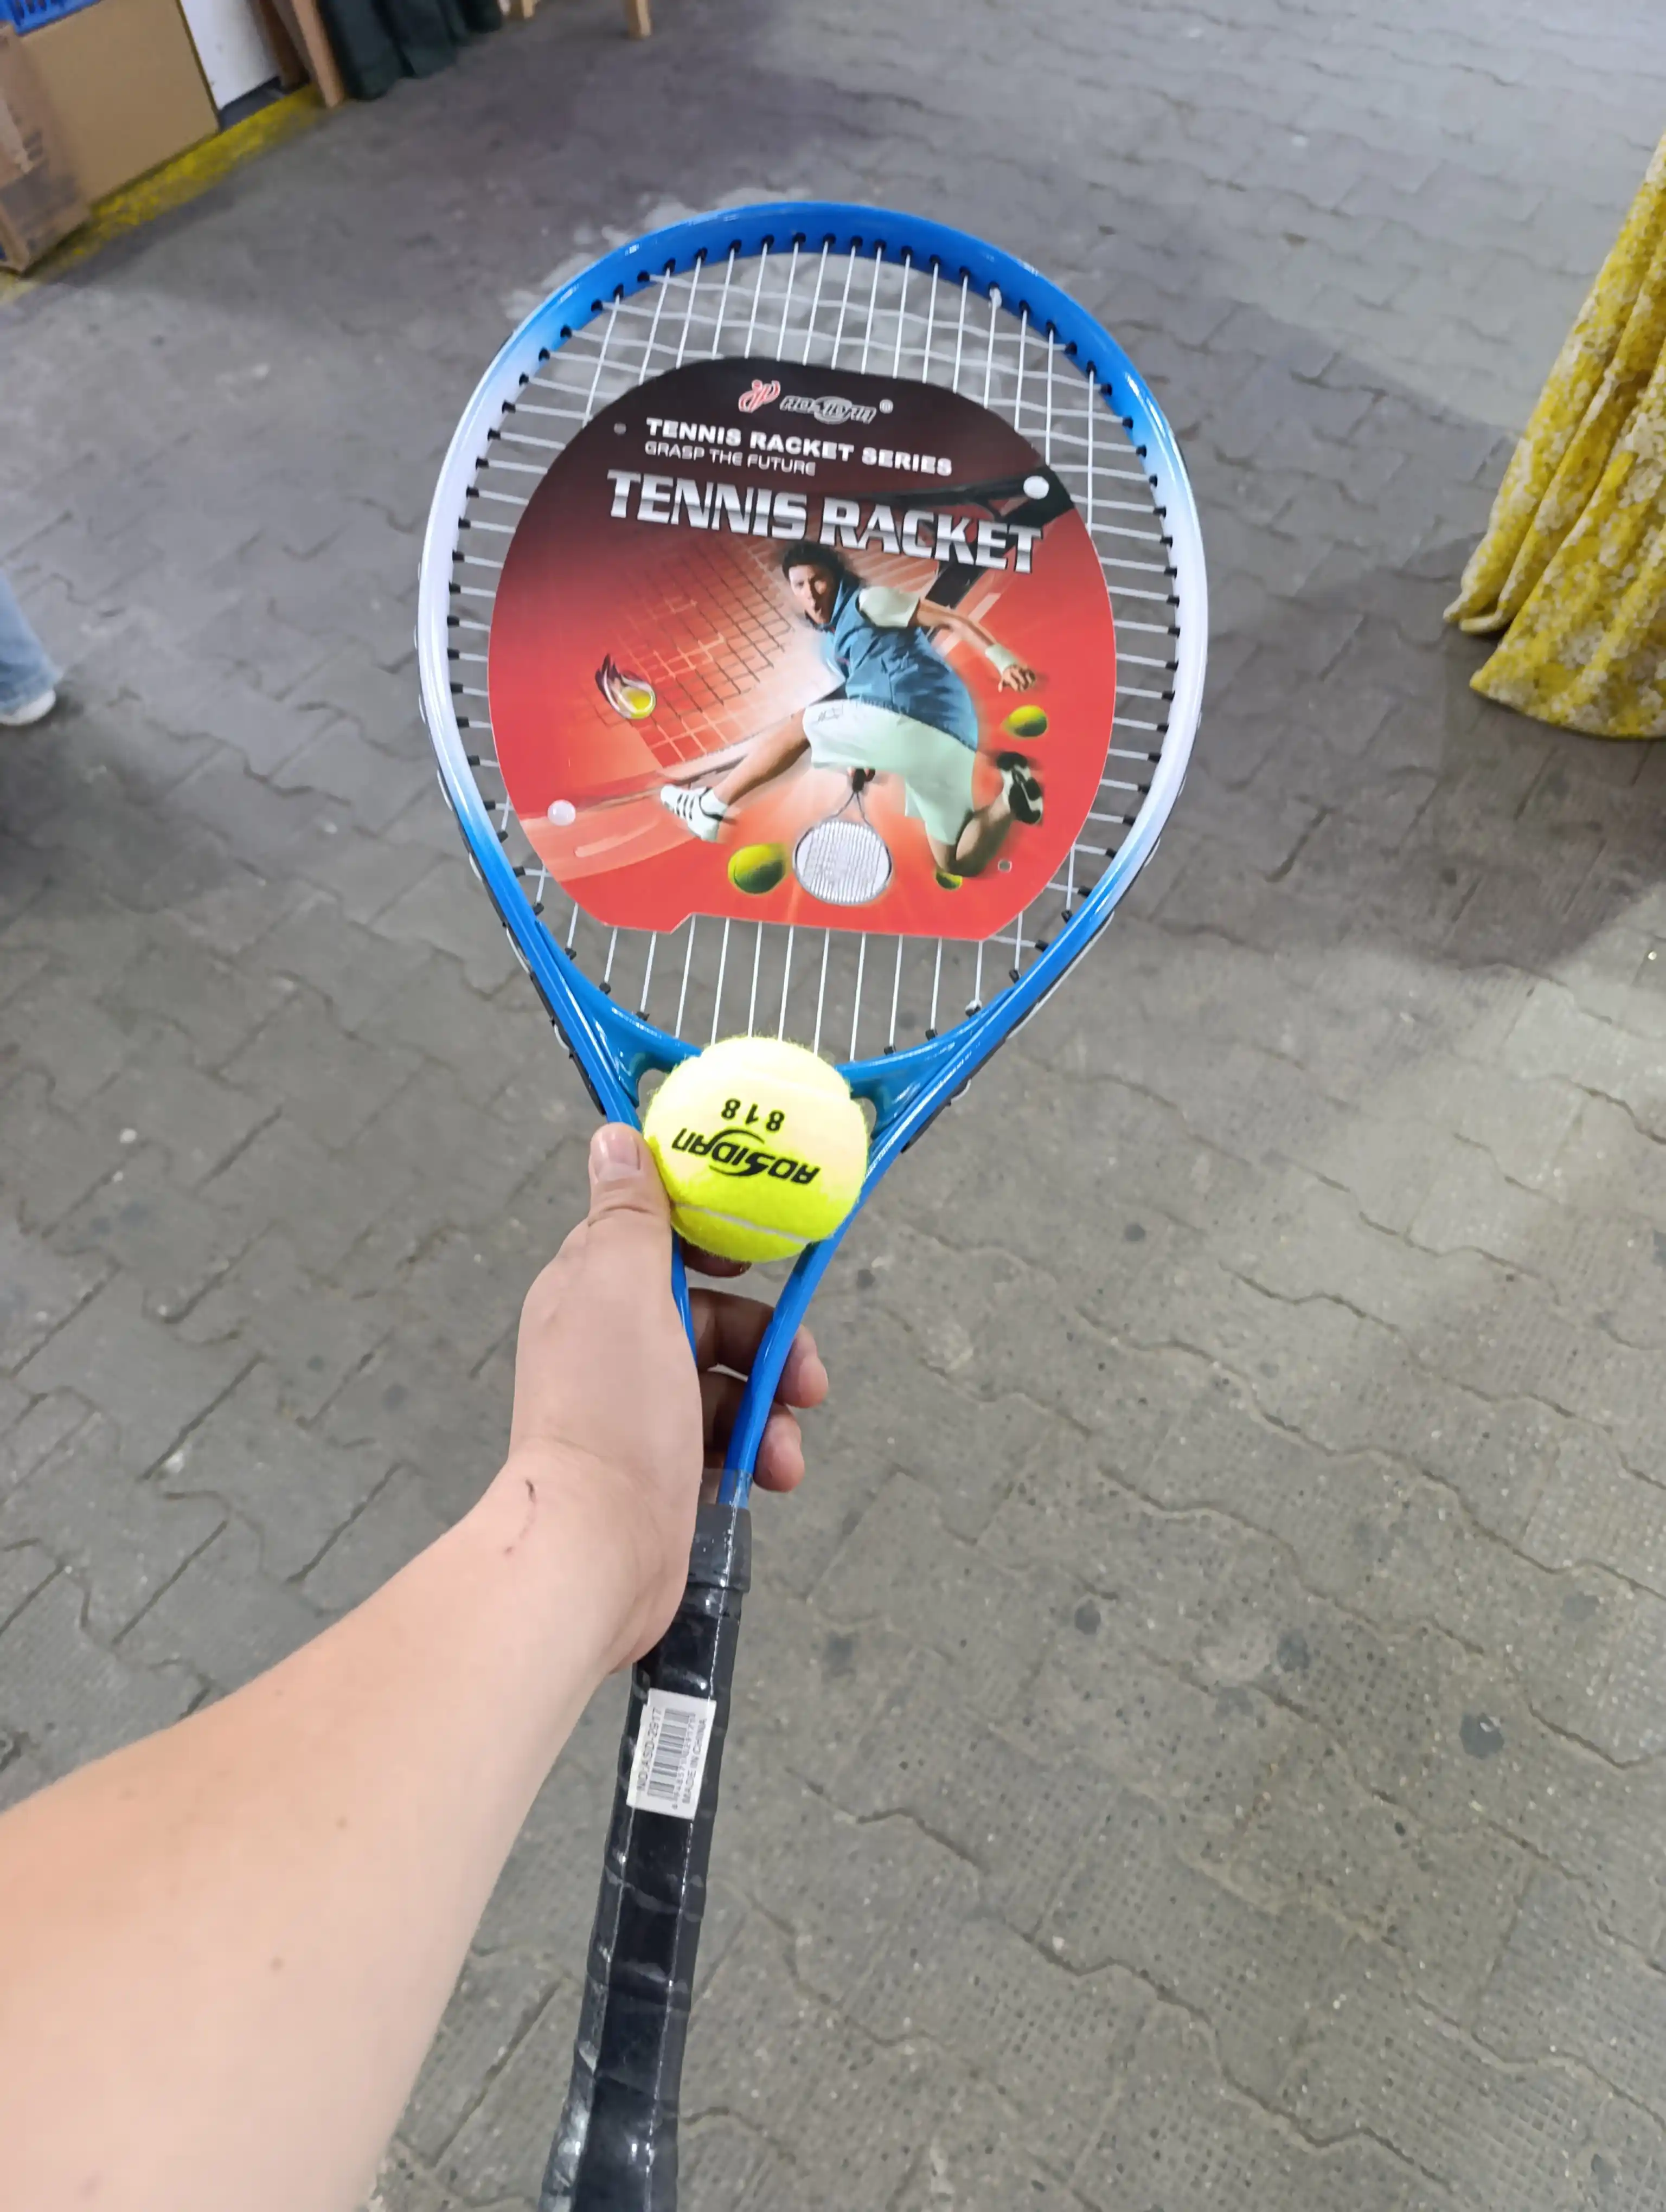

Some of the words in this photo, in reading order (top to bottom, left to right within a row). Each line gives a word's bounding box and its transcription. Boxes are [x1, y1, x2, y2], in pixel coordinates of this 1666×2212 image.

[645, 441, 704, 460] GRASP
[709, 448, 743, 467] THE
[747, 454, 816, 476] FUTURE
[646, 417, 741, 446] TENNIS
[750, 430, 854, 462] RACKET
[862, 447, 952, 476] SERIES
[607, 469, 807, 540] TENNIS
[819, 497, 1042, 575] RACKET
[721, 1098, 785, 1131] 818
[693, 1718, 707, 1754] CHINA
[690, 1756, 700, 1769] IN
[682, 1770, 696, 1804] MADE
